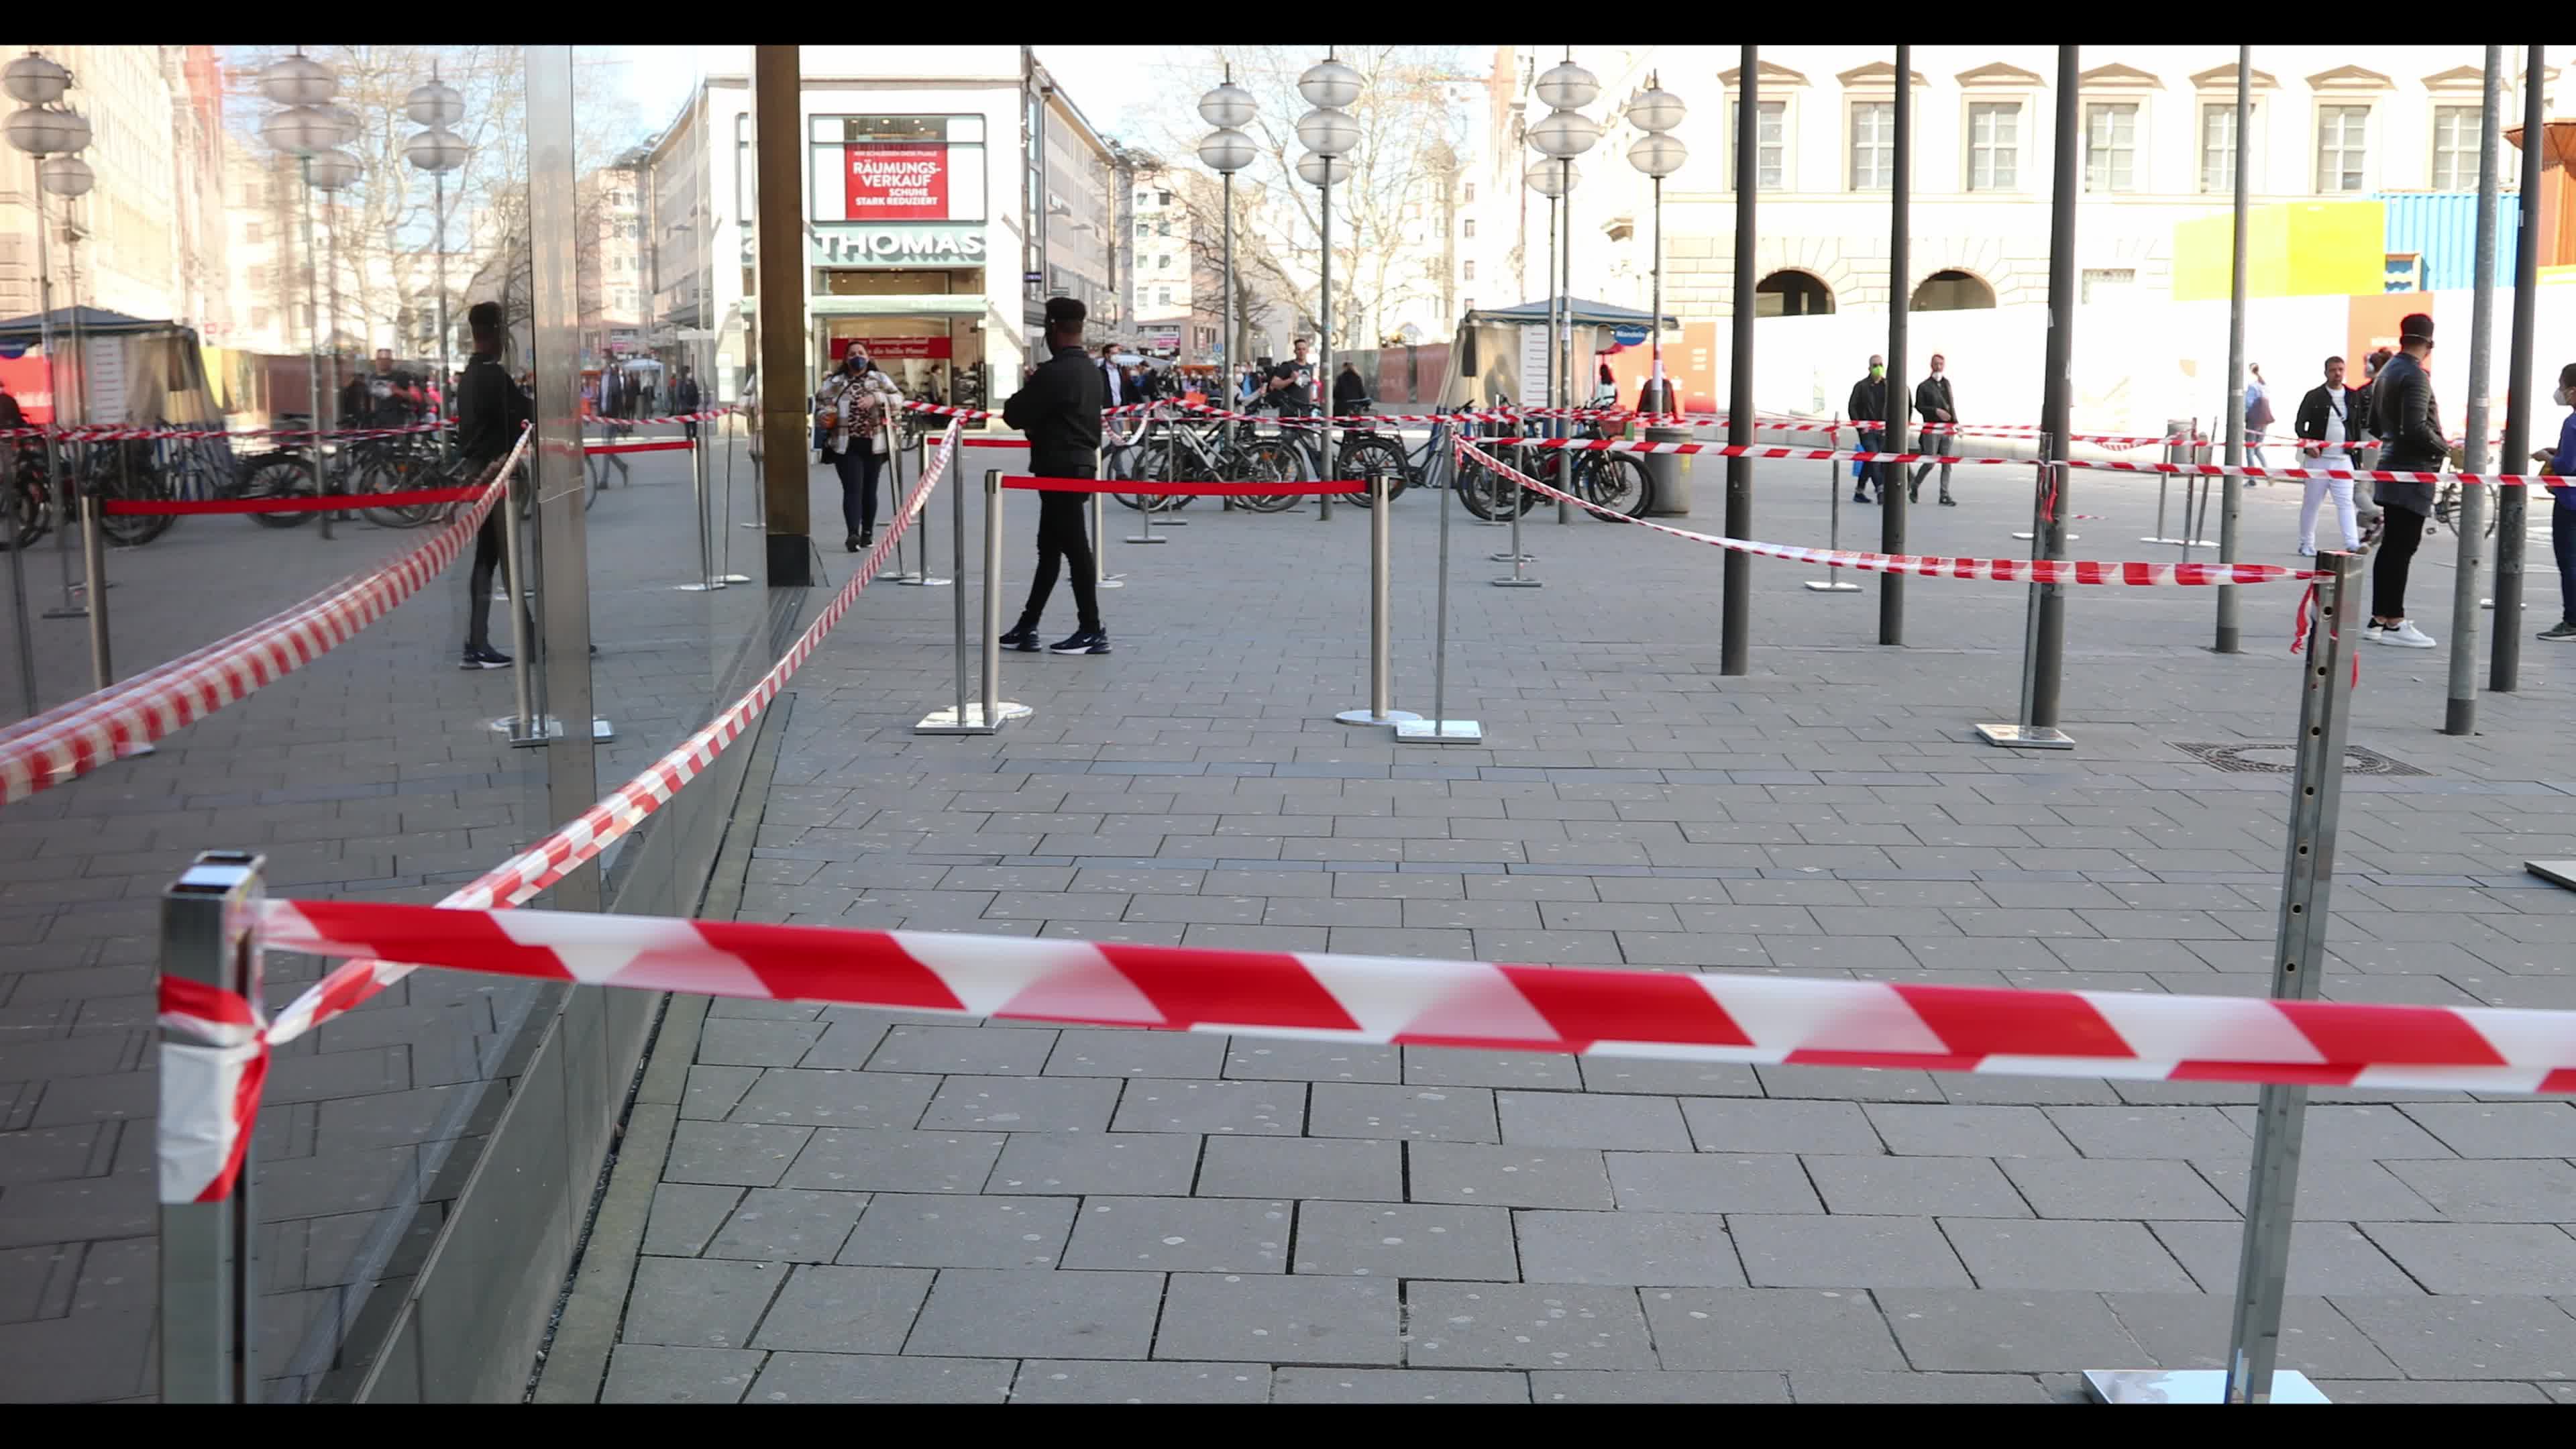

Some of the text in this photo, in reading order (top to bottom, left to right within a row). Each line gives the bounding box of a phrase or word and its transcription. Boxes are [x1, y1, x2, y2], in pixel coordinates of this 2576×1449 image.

[853, 159, 942, 174] RÄUMUNGS-
[861, 174, 931, 187] VERKAUF
[889, 188, 928, 197] SCHUHE
[855, 197, 938, 205] STARK REDUZIERT
[815, 232, 983, 255] THOMAS
